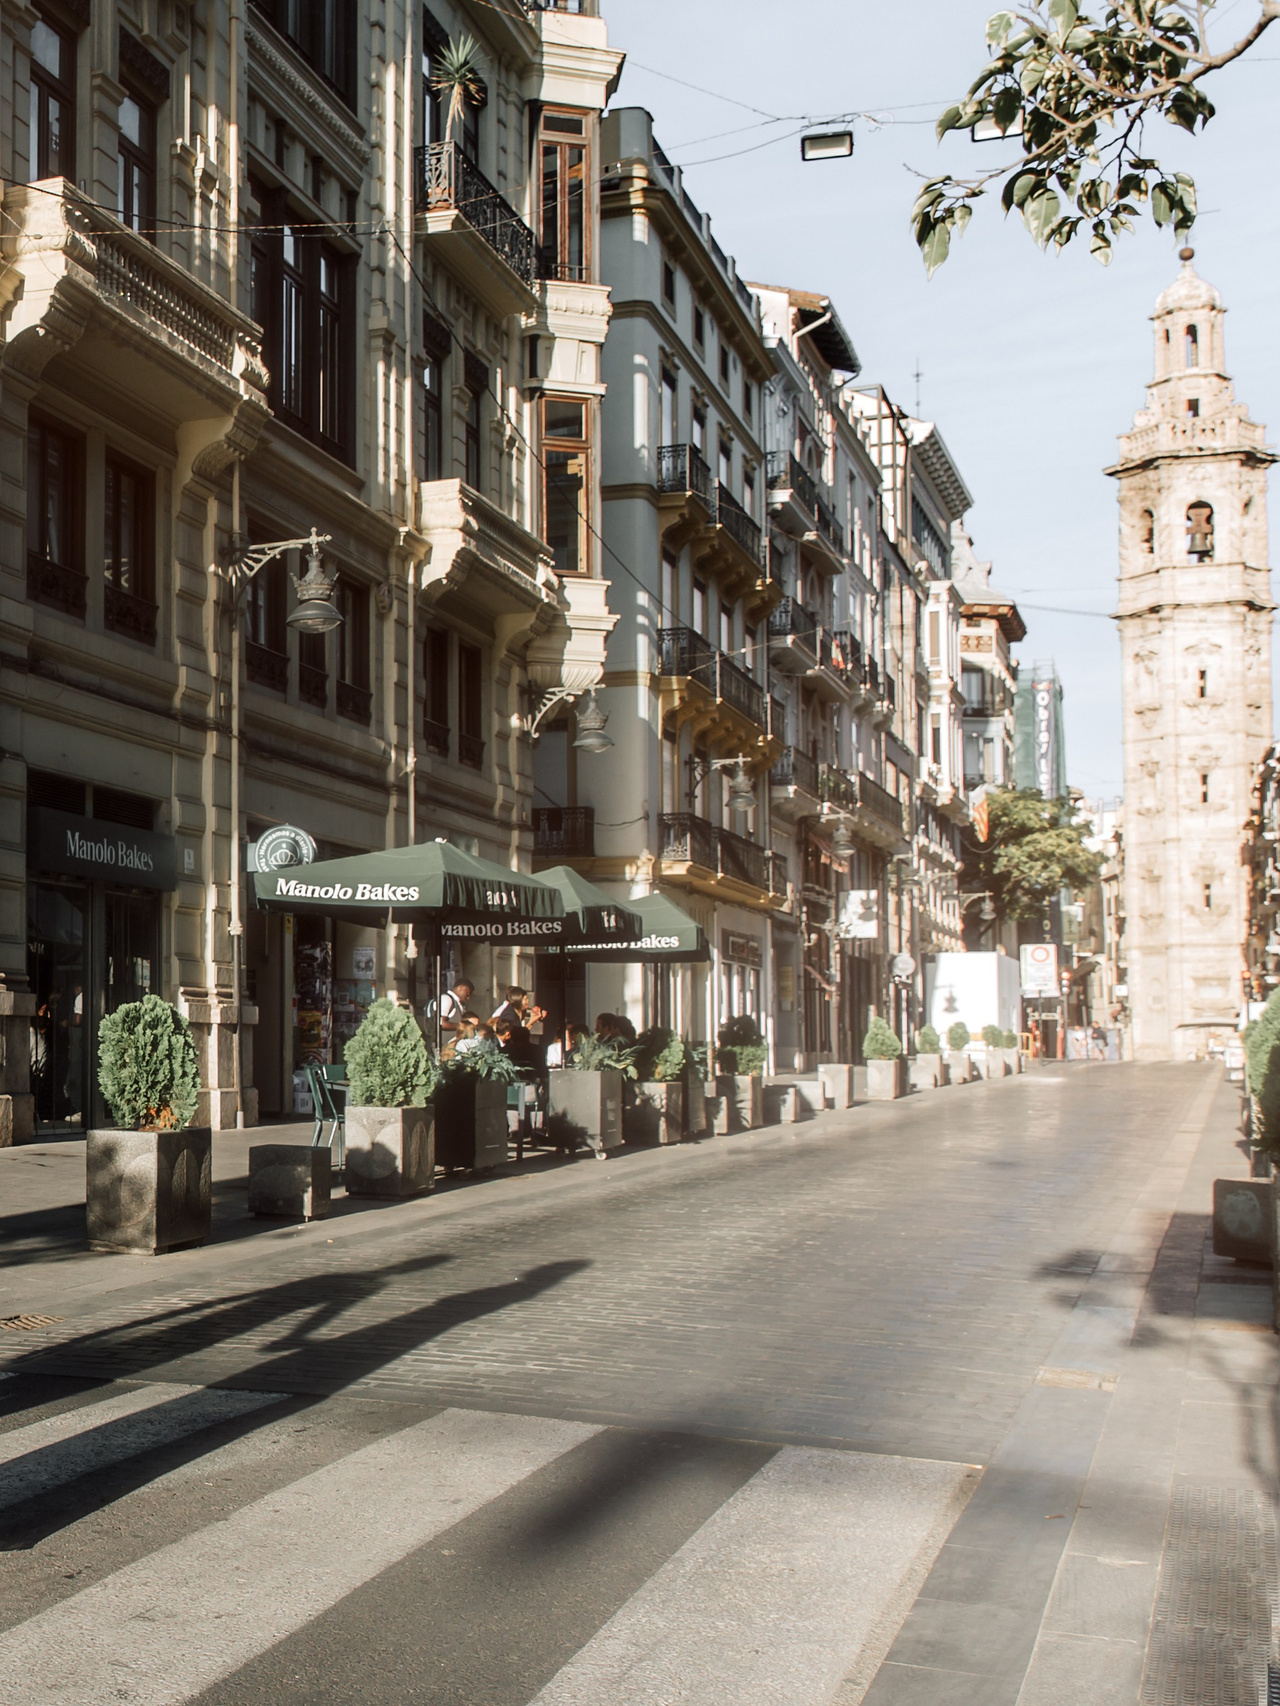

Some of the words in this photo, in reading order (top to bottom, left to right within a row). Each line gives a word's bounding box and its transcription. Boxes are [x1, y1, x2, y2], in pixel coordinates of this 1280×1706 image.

[67, 830, 115, 865] Manolo
[118, 840, 154, 872] Bakes
[275, 878, 353, 900] Manolo
[355, 883, 420, 901] Bakes
